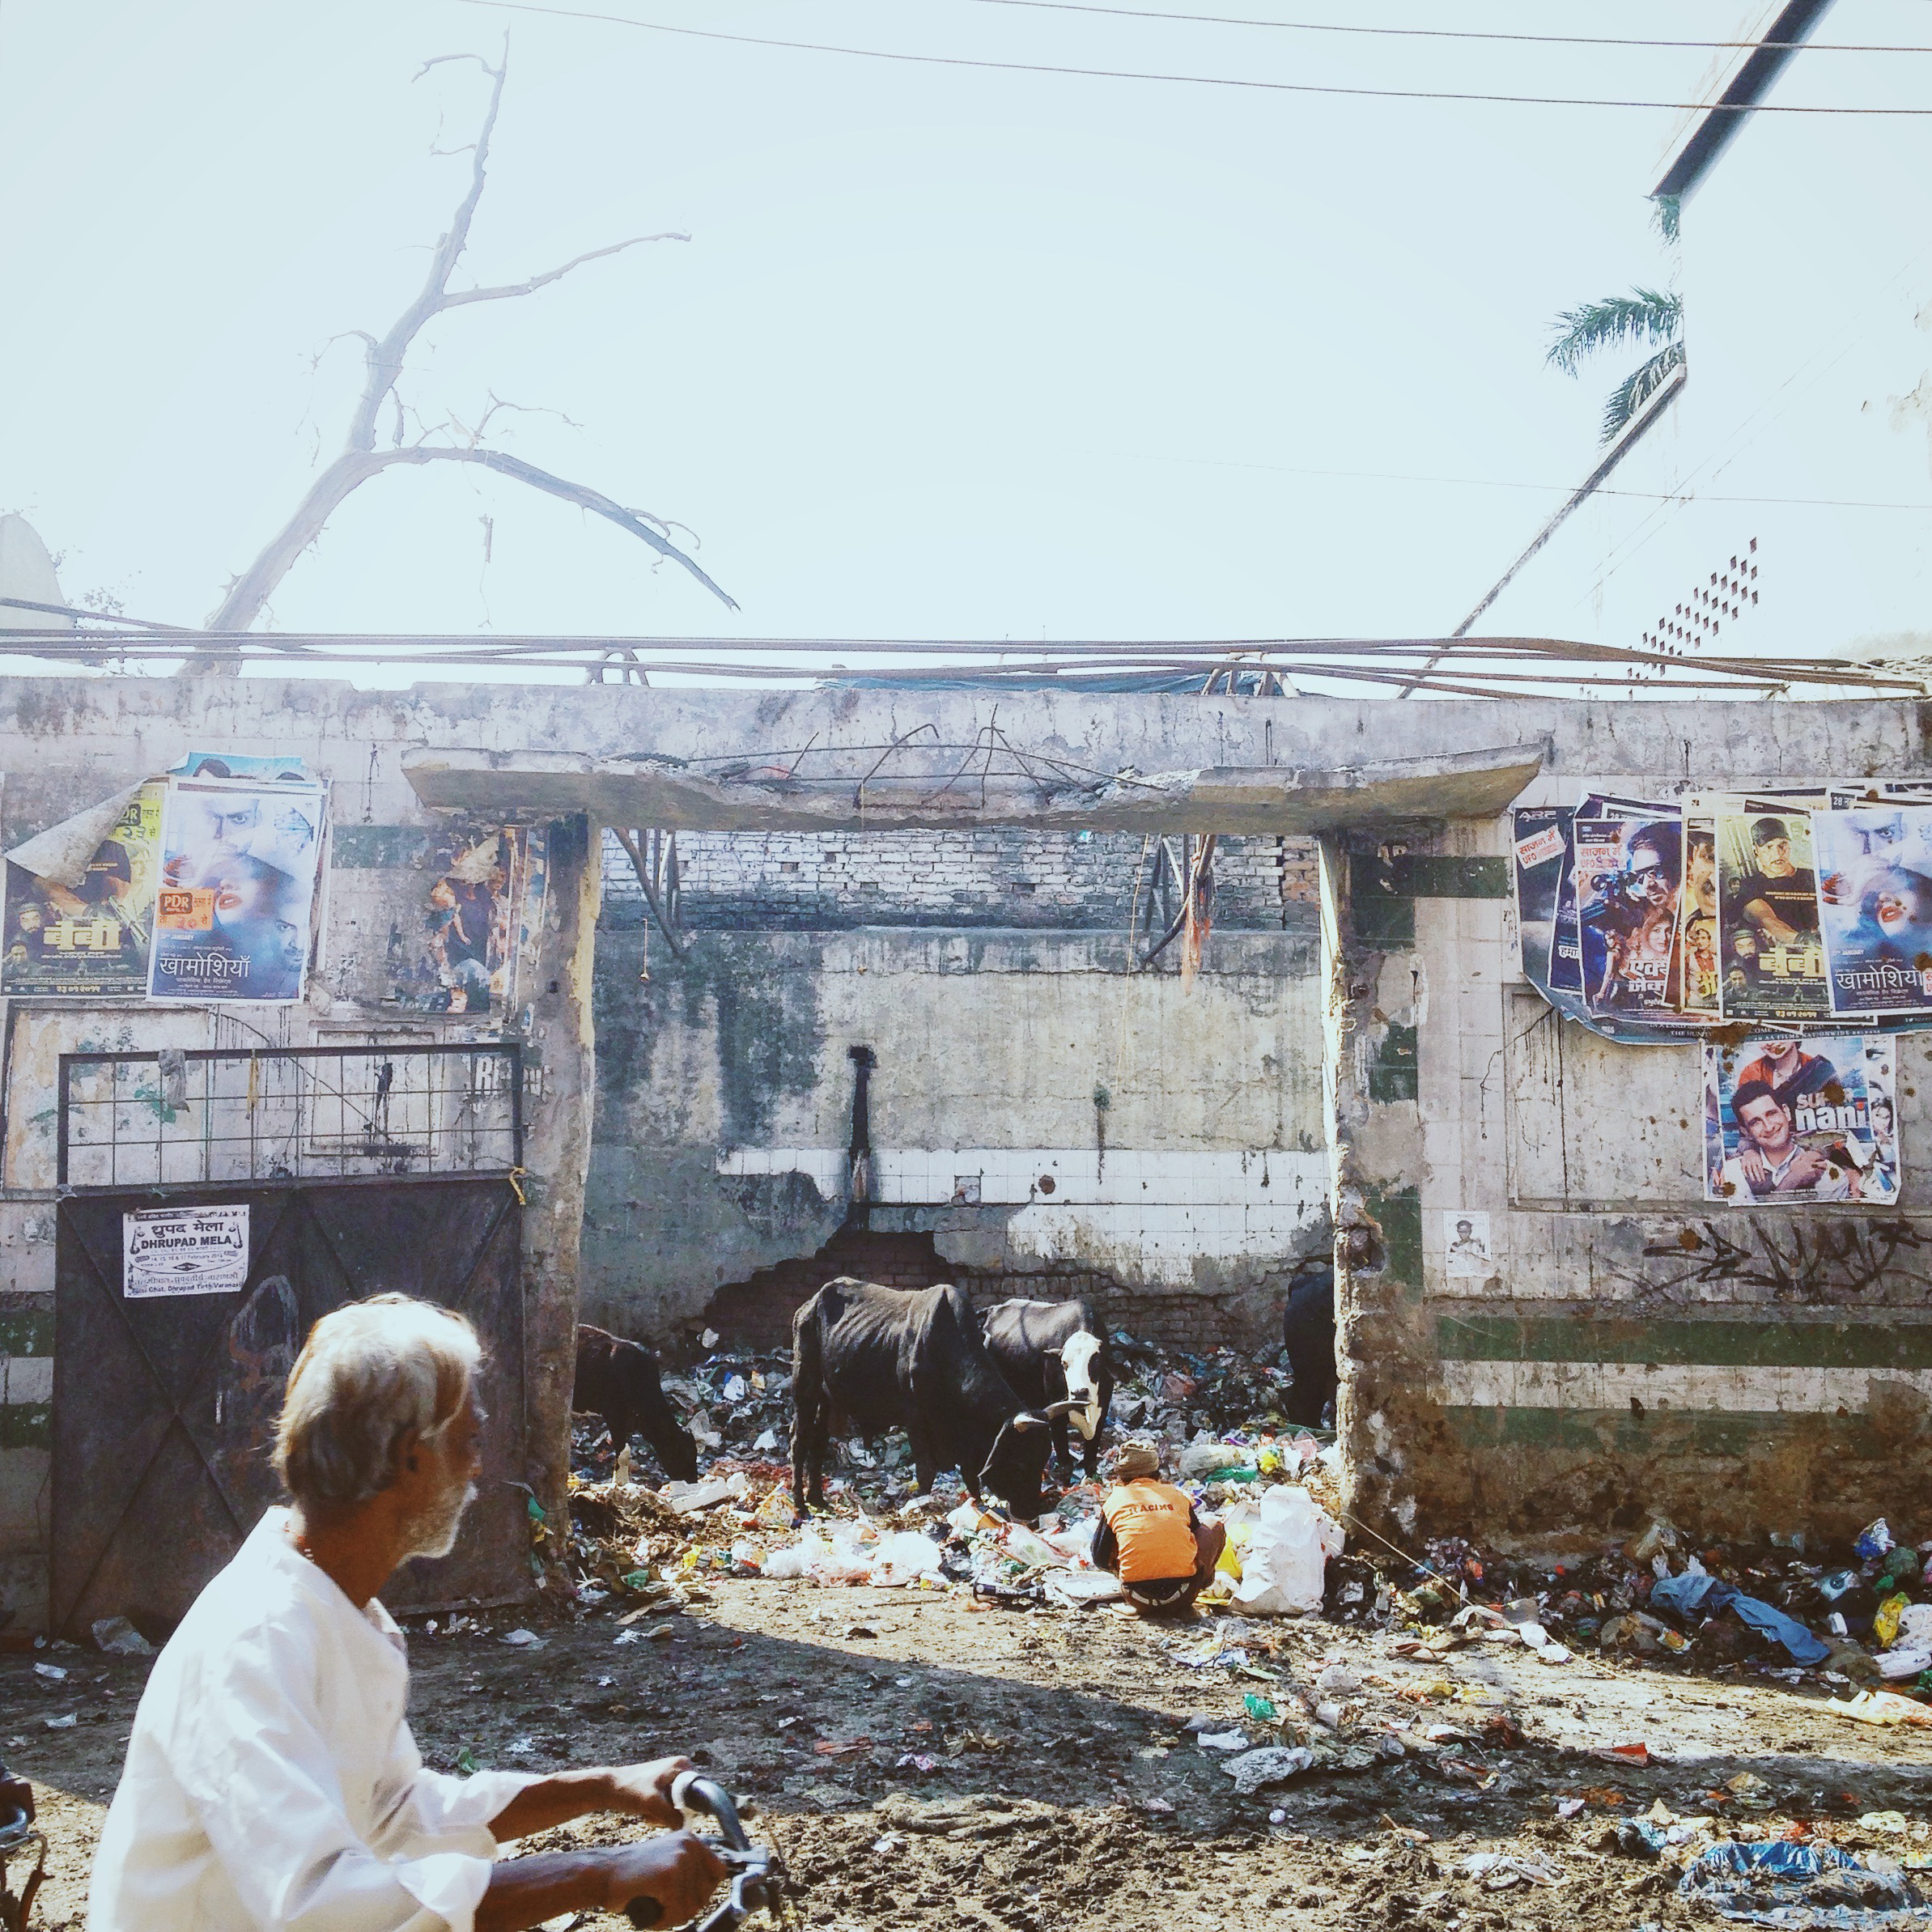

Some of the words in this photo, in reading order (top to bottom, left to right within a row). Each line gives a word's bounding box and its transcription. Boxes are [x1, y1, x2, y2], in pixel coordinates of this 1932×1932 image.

[1522, 852, 1537, 864] UFO
[1581, 859, 1595, 868] UFO
[164, 894, 189, 908] PDR
[159, 952, 252, 978] खामोशियाँ
[1795, 1101, 1866, 1132] nani
[193, 1220, 224, 1233] मेला
[141, 1237, 197, 1250] DHRUPAD
[200, 1235, 232, 1246] MELA
